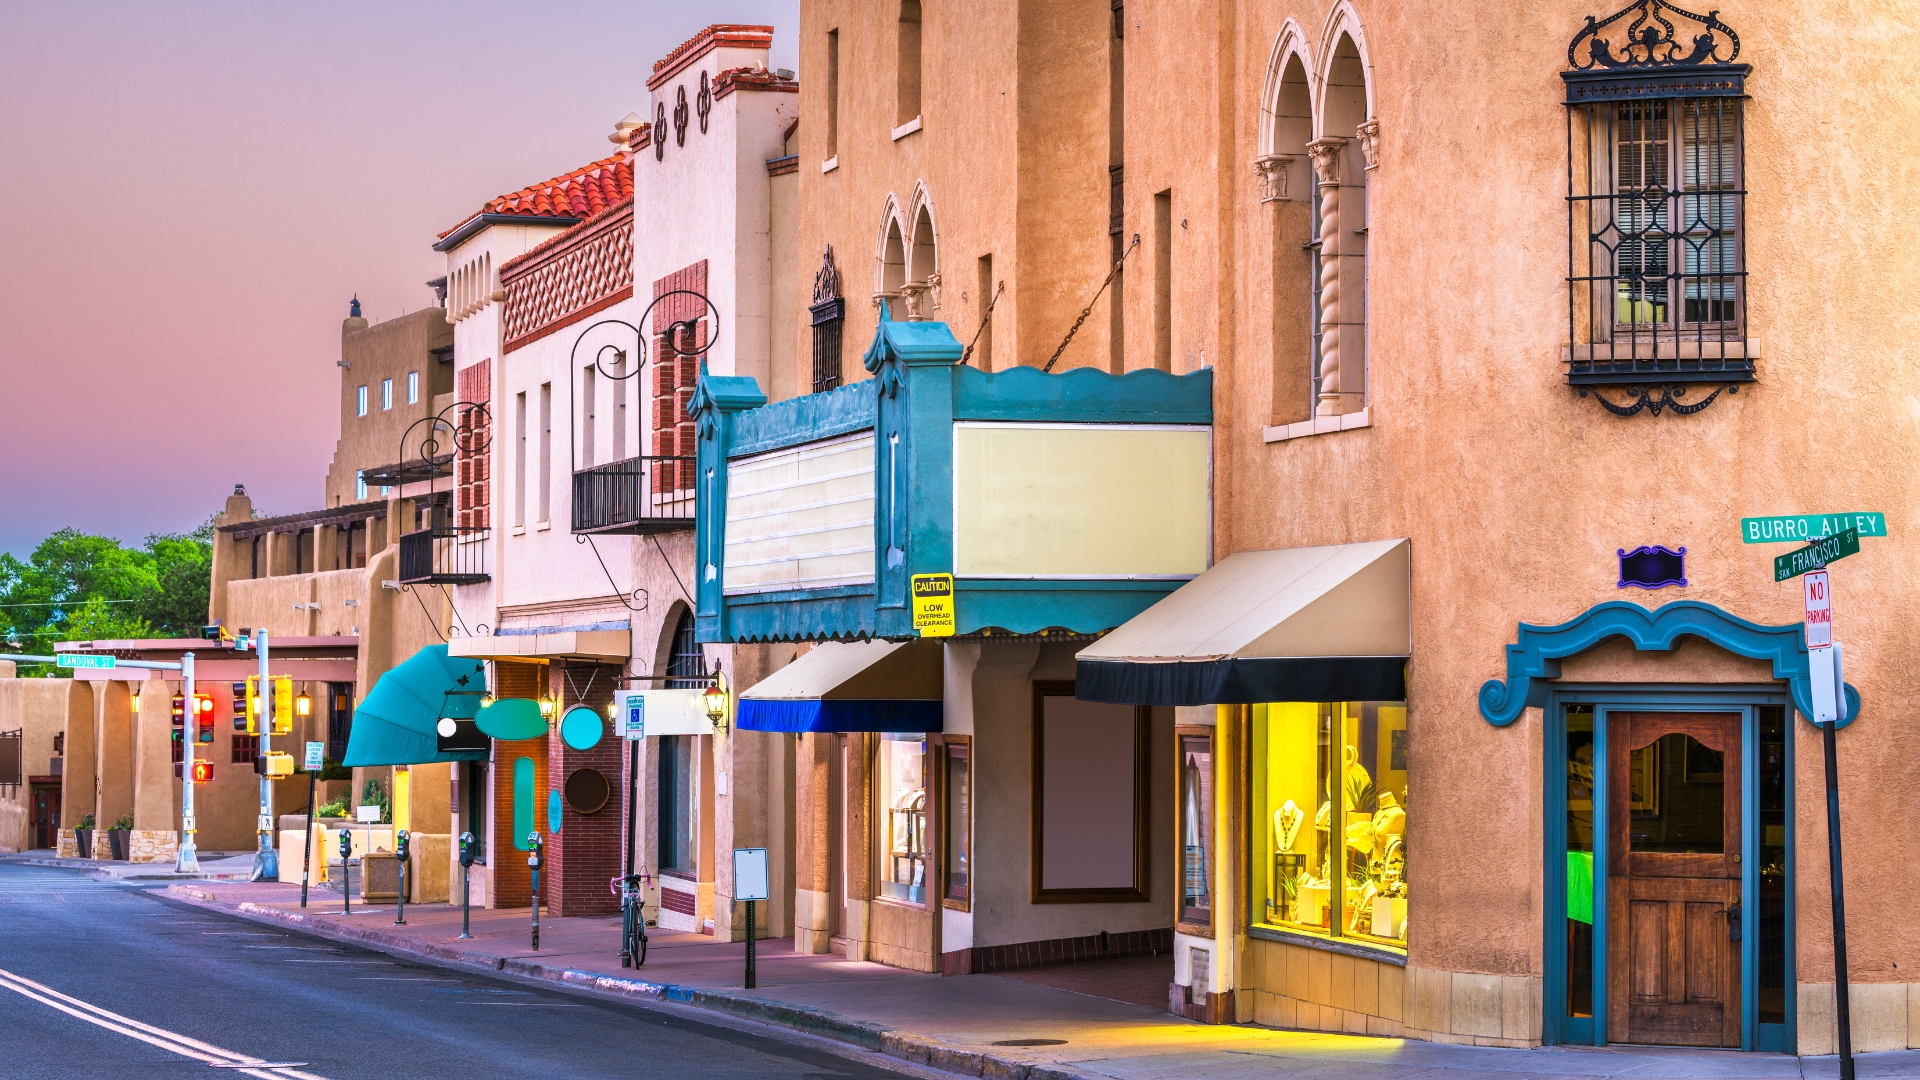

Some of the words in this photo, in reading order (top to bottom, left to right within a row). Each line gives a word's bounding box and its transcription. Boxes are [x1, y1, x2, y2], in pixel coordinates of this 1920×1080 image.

[1749, 519, 1808, 540] BURRO
[1822, 515, 1877, 536] ALLEY
[1778, 567, 1790, 579] SAN
[1792, 538, 1840, 573] FRANCISCO
[1847, 532, 1854, 543] ST
[915, 581, 950, 592] CAUTION
[1810, 581, 1824, 601] NO
[924, 604, 944, 612] LOW
[1807, 608, 1830, 624] PARKING
[62, 655, 98, 667] SANDOVAL
[102, 657, 110, 667] ST
